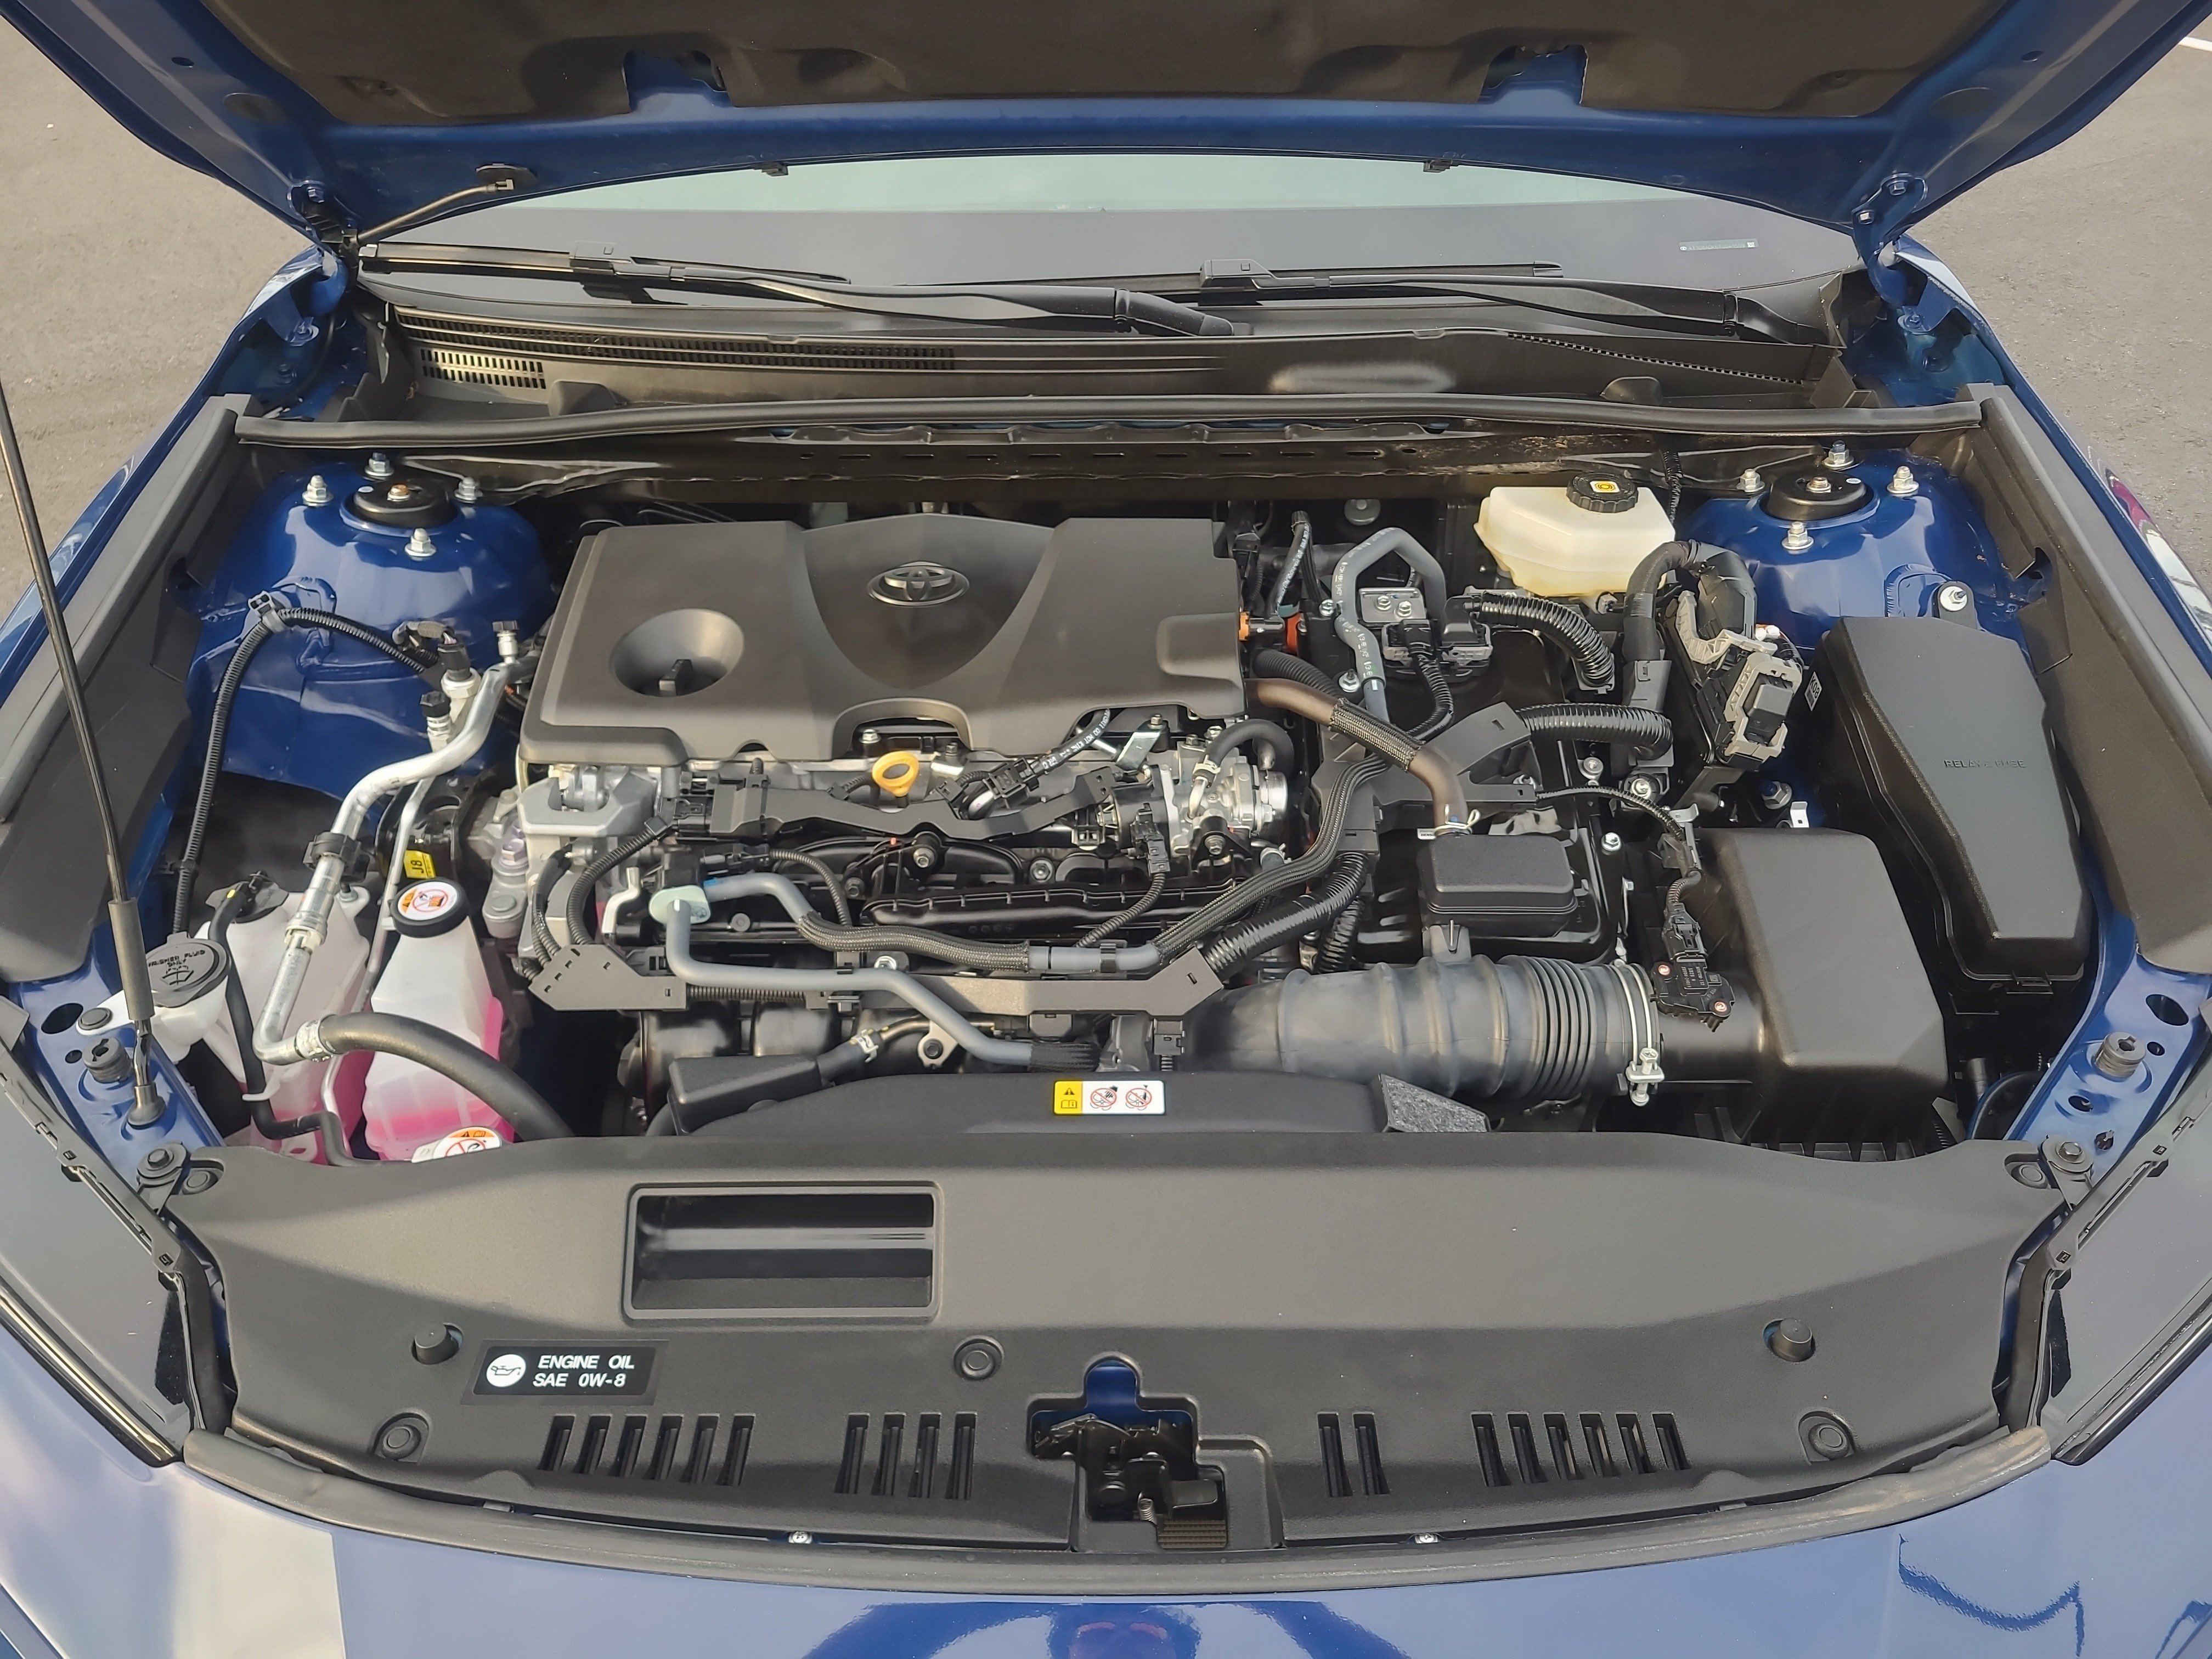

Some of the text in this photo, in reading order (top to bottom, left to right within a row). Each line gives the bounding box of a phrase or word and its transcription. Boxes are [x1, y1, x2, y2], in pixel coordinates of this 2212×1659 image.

[1810, 675, 1820, 698] K08
[1944, 760, 1980, 768] RELAY
[538, 1355, 635, 1369] ENGINE OIL
[533, 1373, 627, 1387] SAE 0W-8
